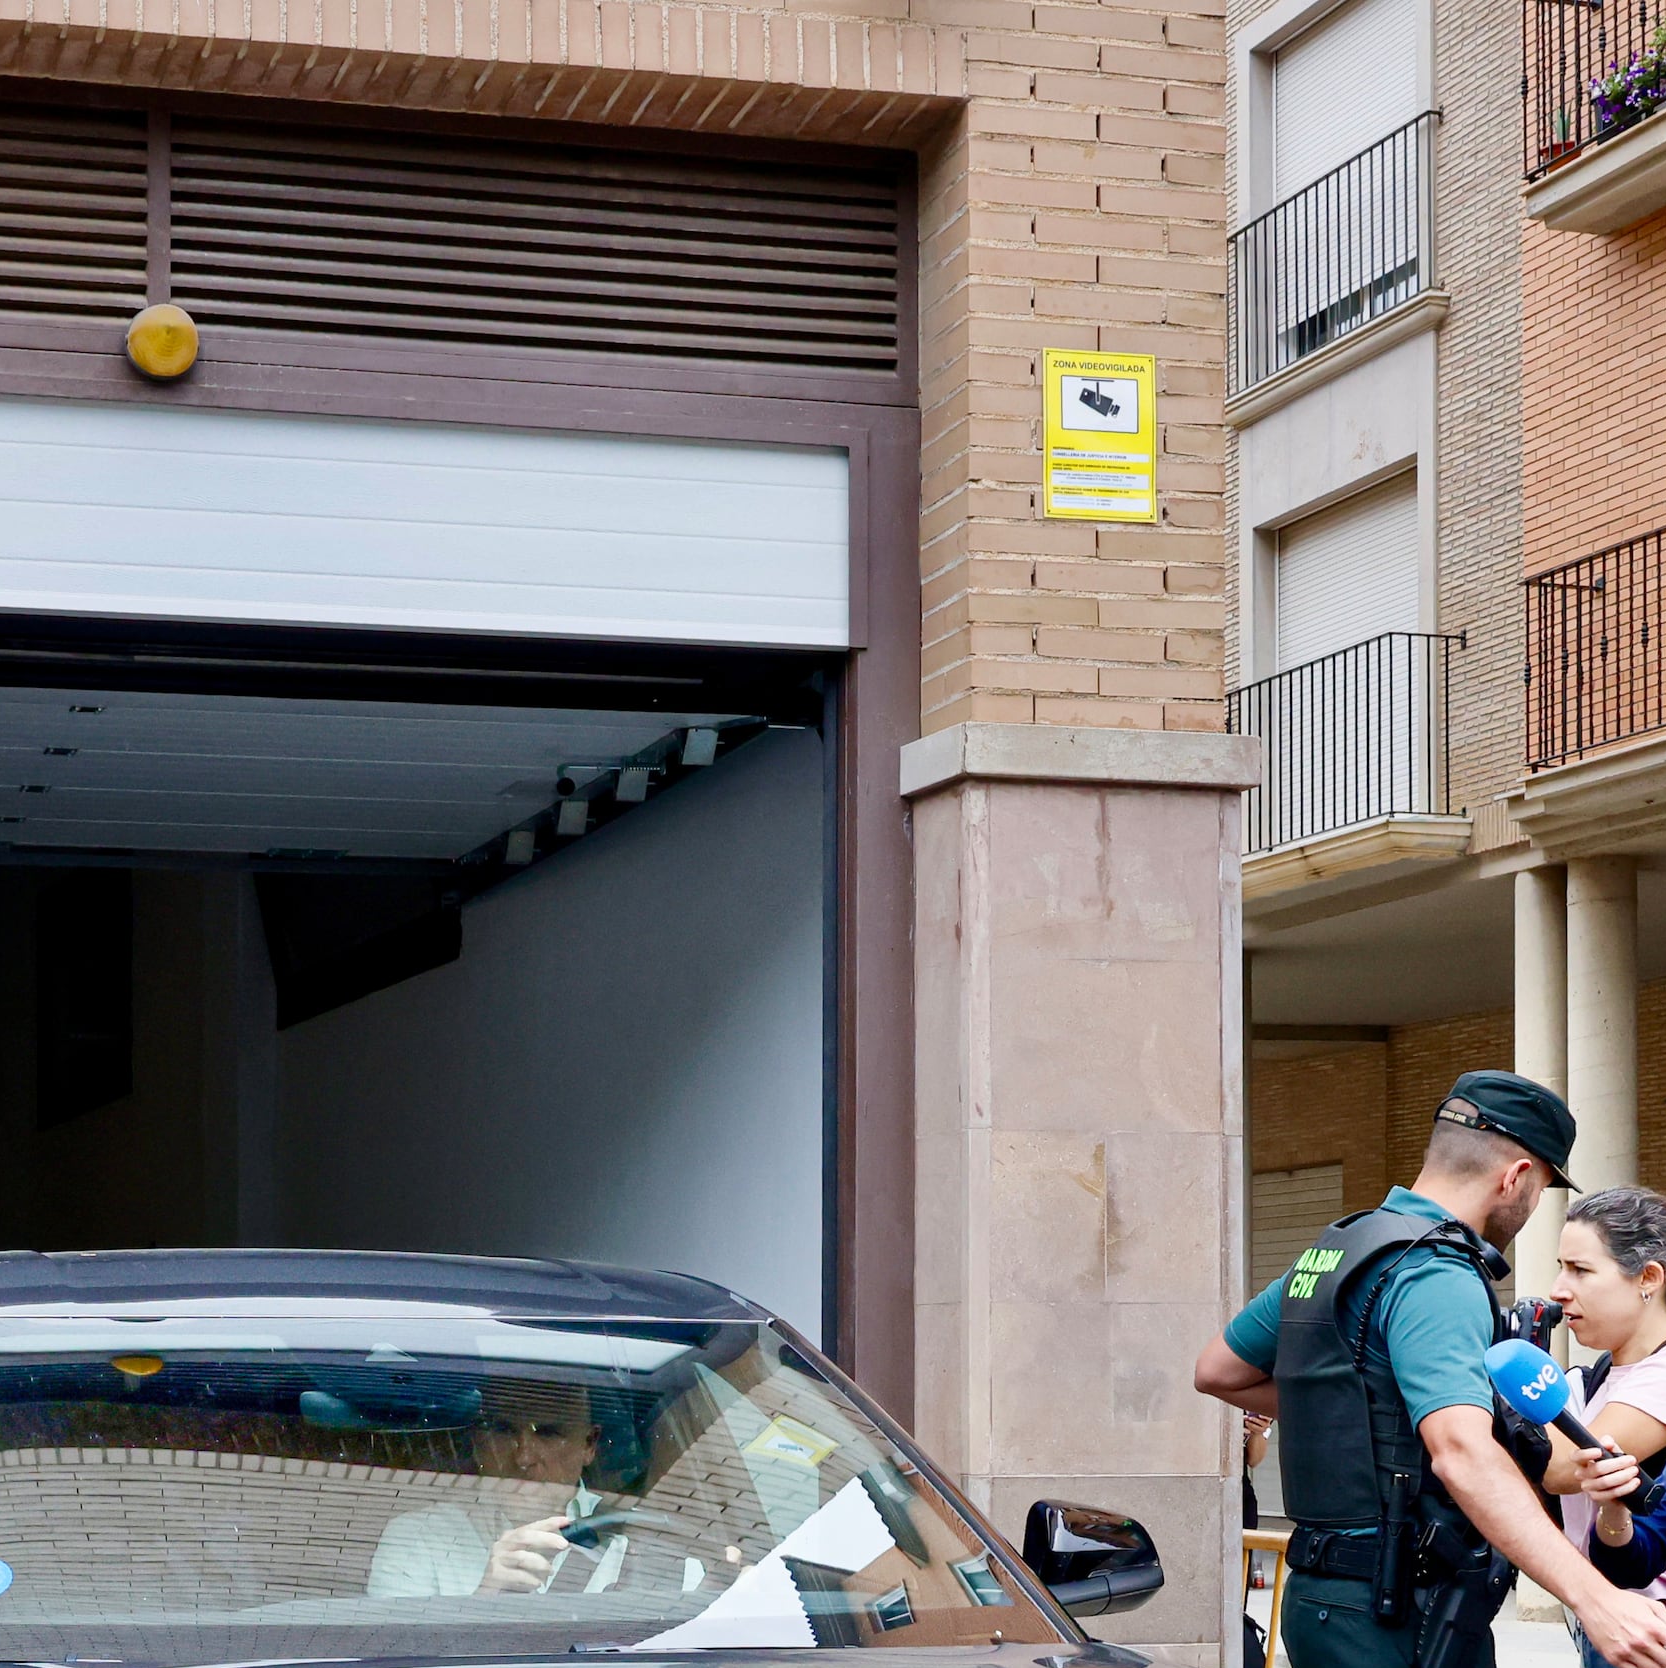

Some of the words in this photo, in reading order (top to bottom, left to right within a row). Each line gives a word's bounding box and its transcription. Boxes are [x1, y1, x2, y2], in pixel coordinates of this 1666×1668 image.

[1053, 360, 1077, 369] ZONA
[1079, 362, 1146, 373] VIDEOVIGILADA
[1521, 1364, 1559, 1401] tve
